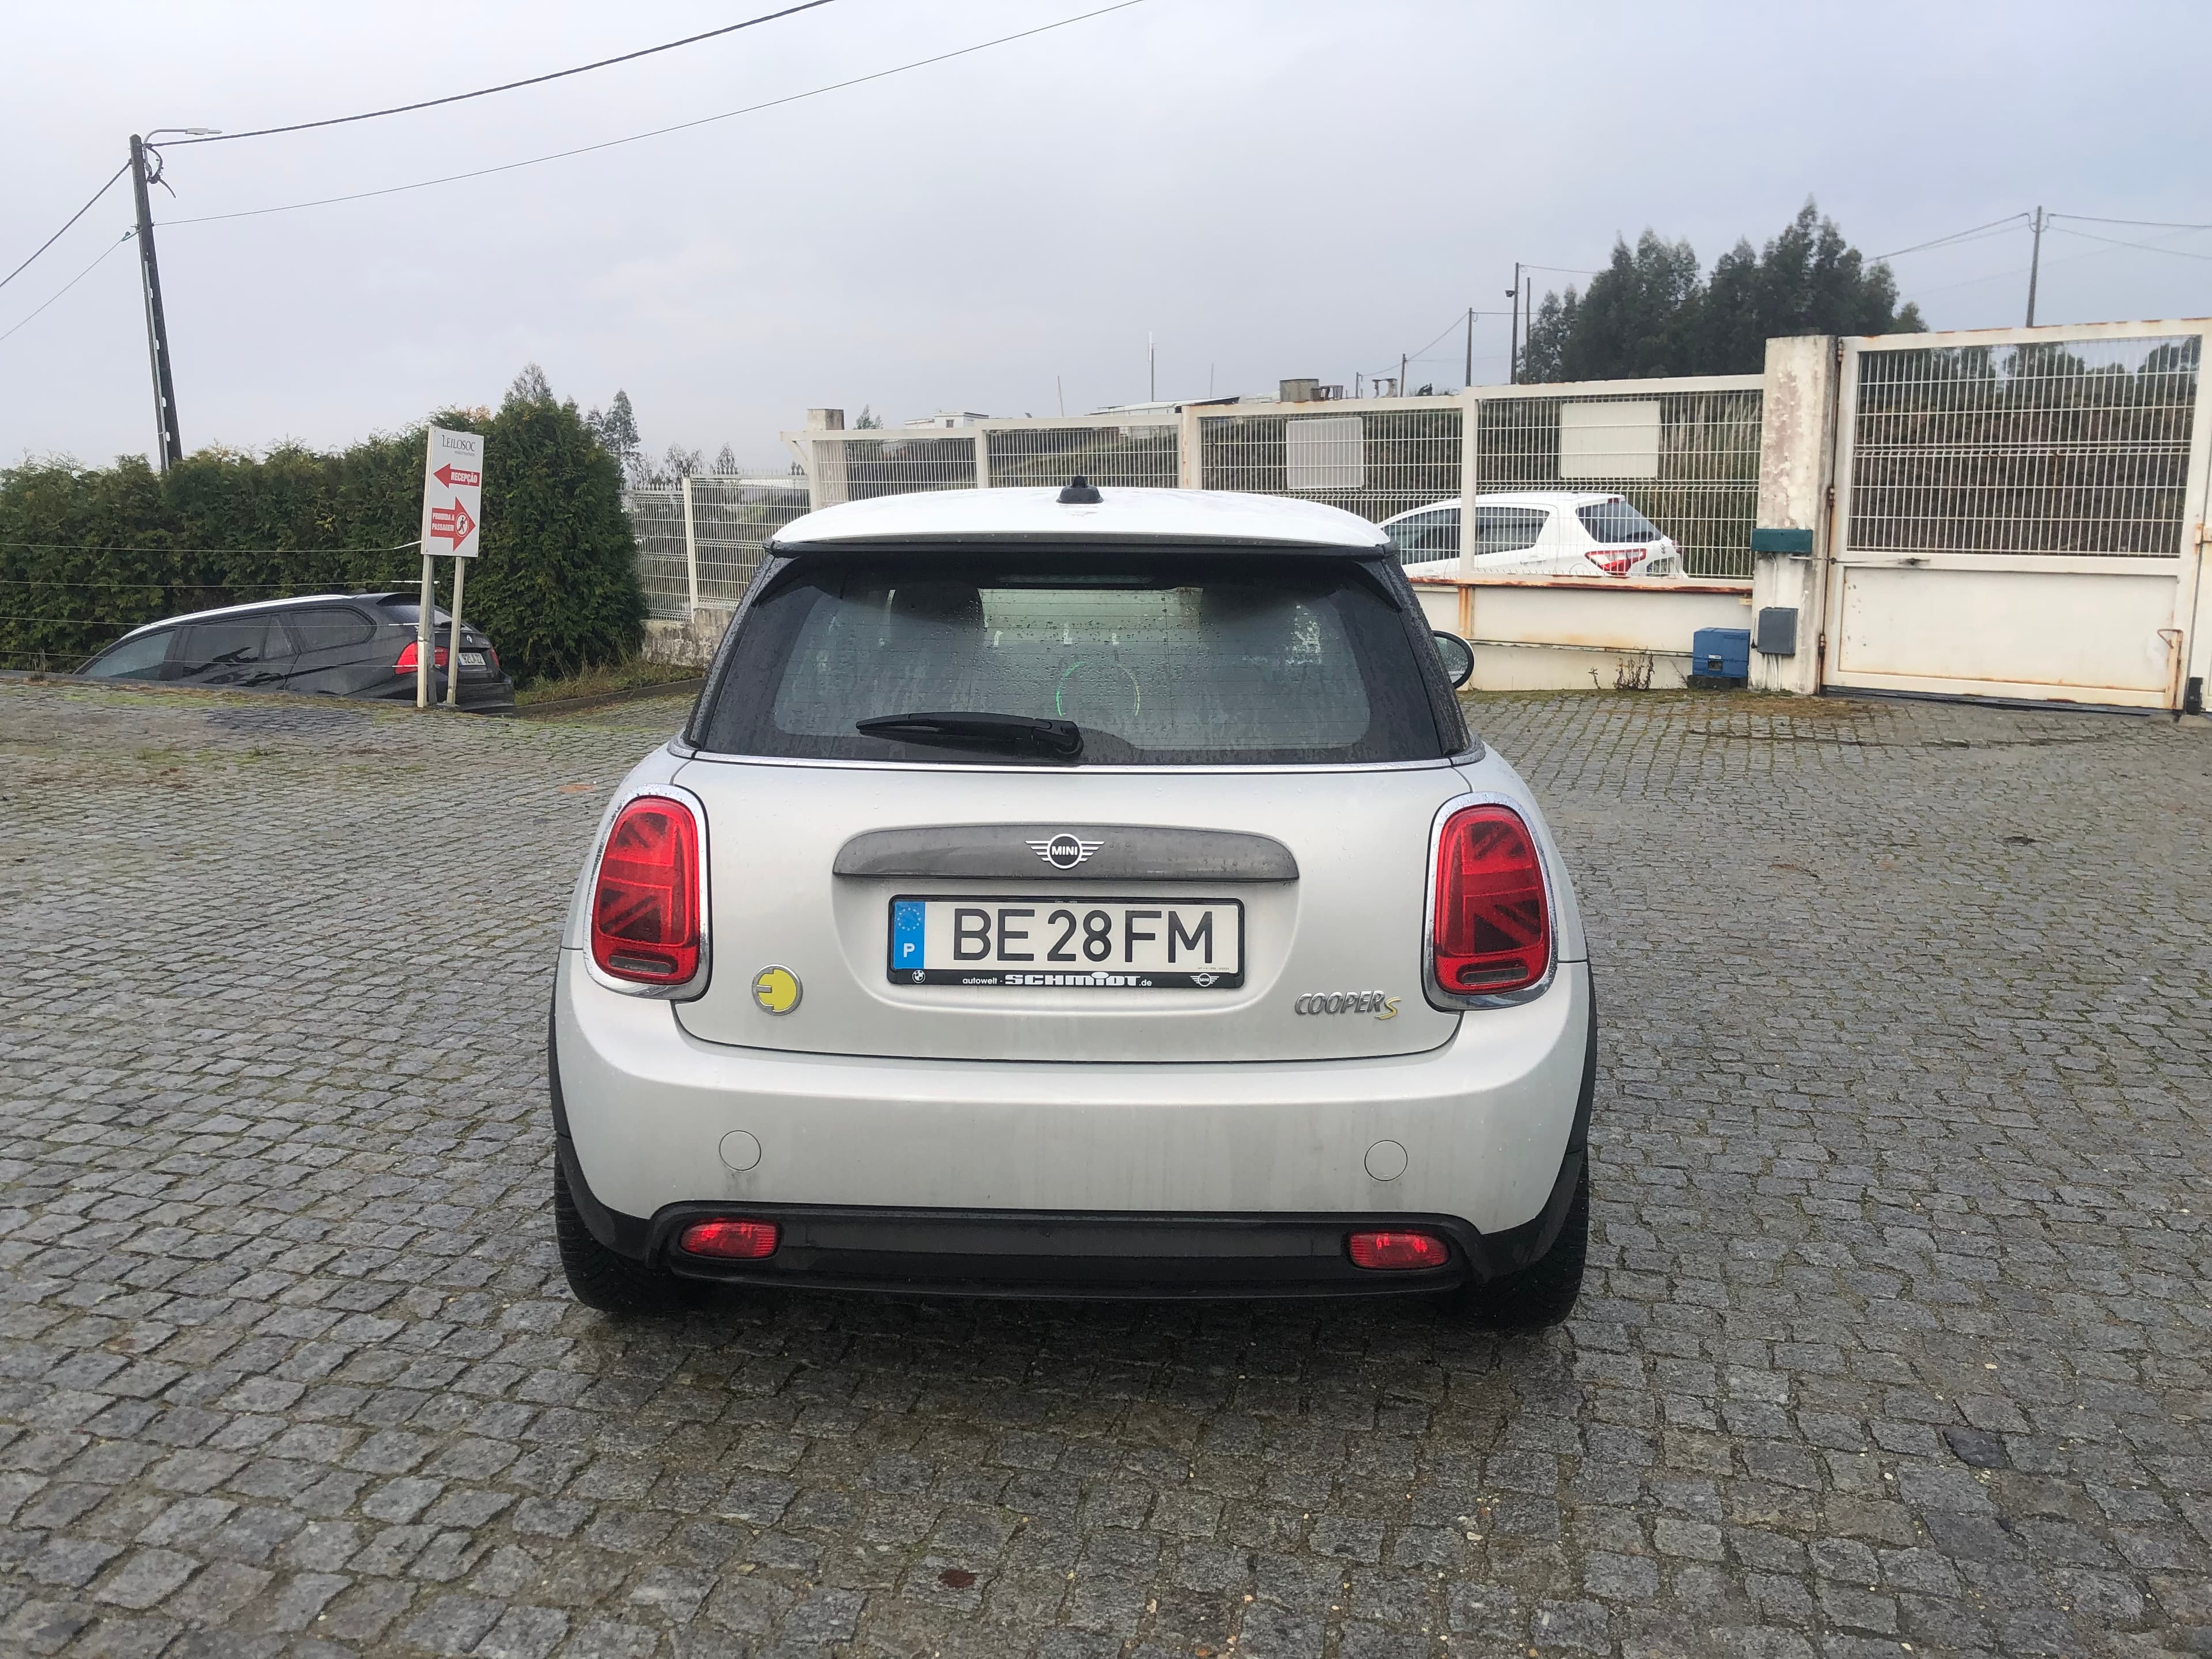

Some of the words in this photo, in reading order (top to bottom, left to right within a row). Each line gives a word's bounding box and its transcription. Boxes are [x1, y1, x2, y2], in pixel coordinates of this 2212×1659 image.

[442, 434, 476, 452] LEILOSOC
[451, 471, 478, 484] RECEPÇÃO
[1051, 846, 1078, 855] MINI
[903, 943, 915, 958] P
[1295, 990, 1385, 1015] COOPER
